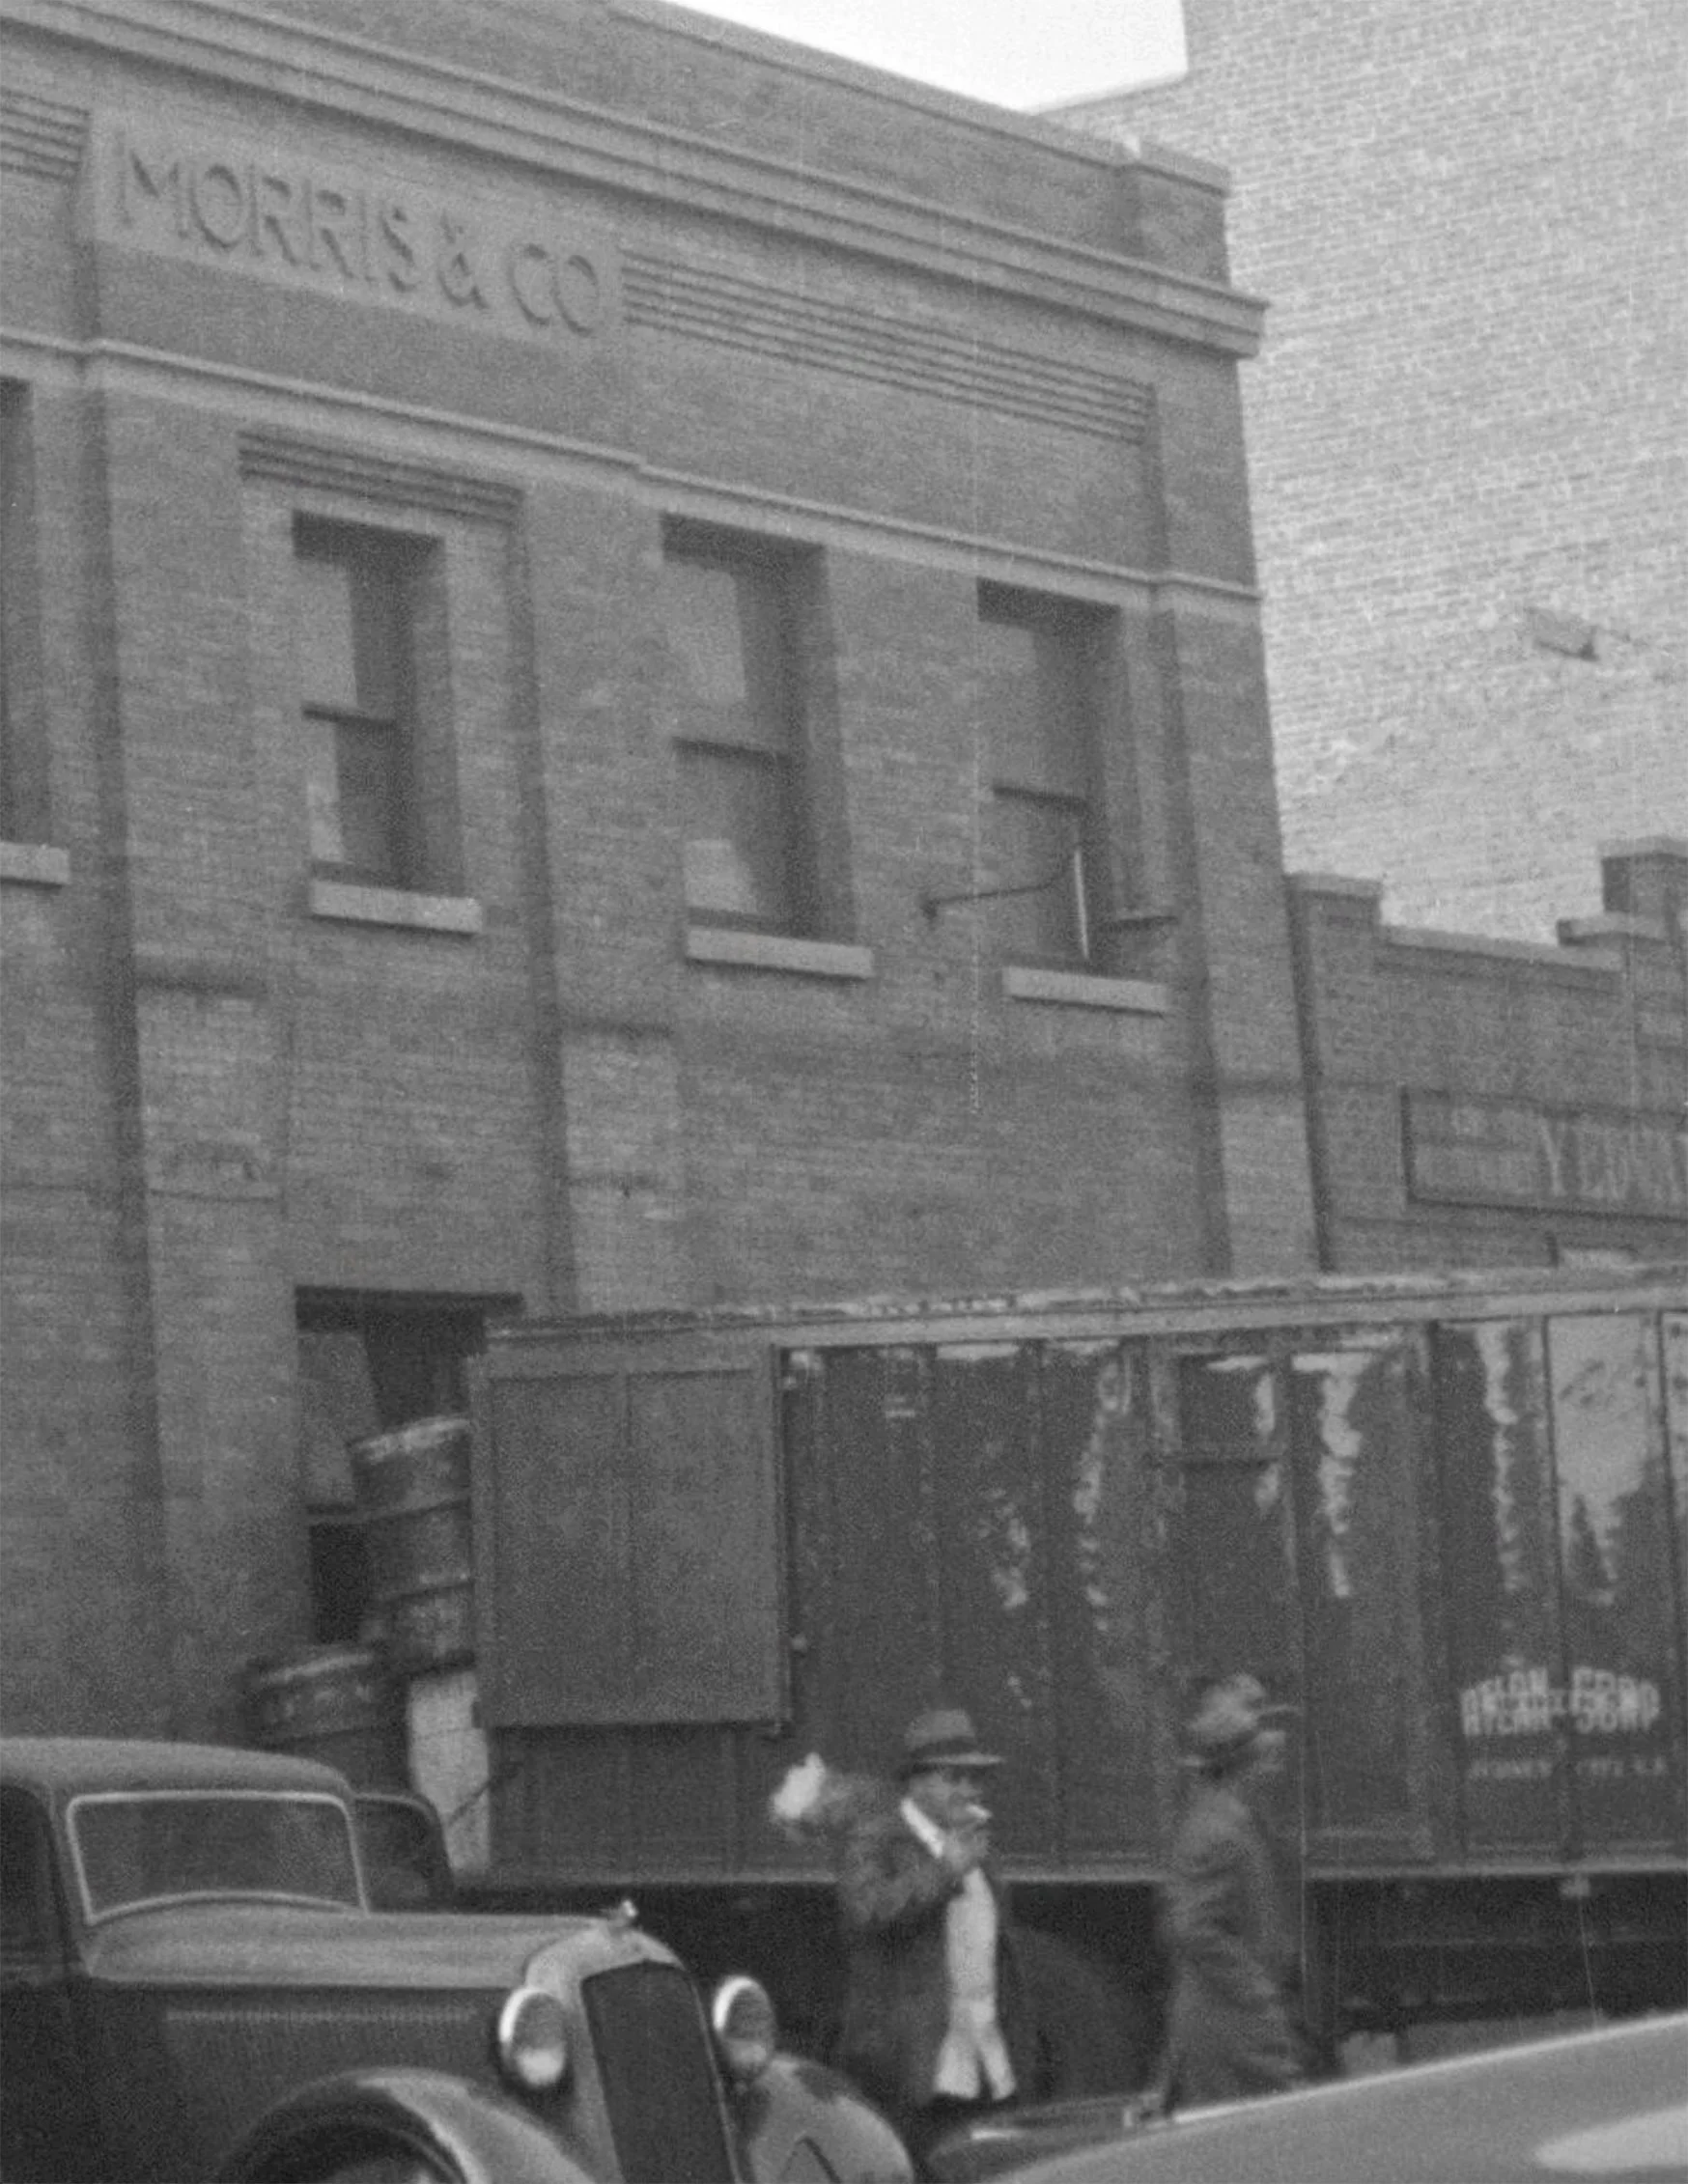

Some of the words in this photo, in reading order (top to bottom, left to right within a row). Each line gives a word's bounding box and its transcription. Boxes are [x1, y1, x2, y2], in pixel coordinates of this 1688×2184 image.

[113, 127, 418, 293] MORRIS
[436, 212, 489, 311] &
[506, 241, 603, 336] CO
